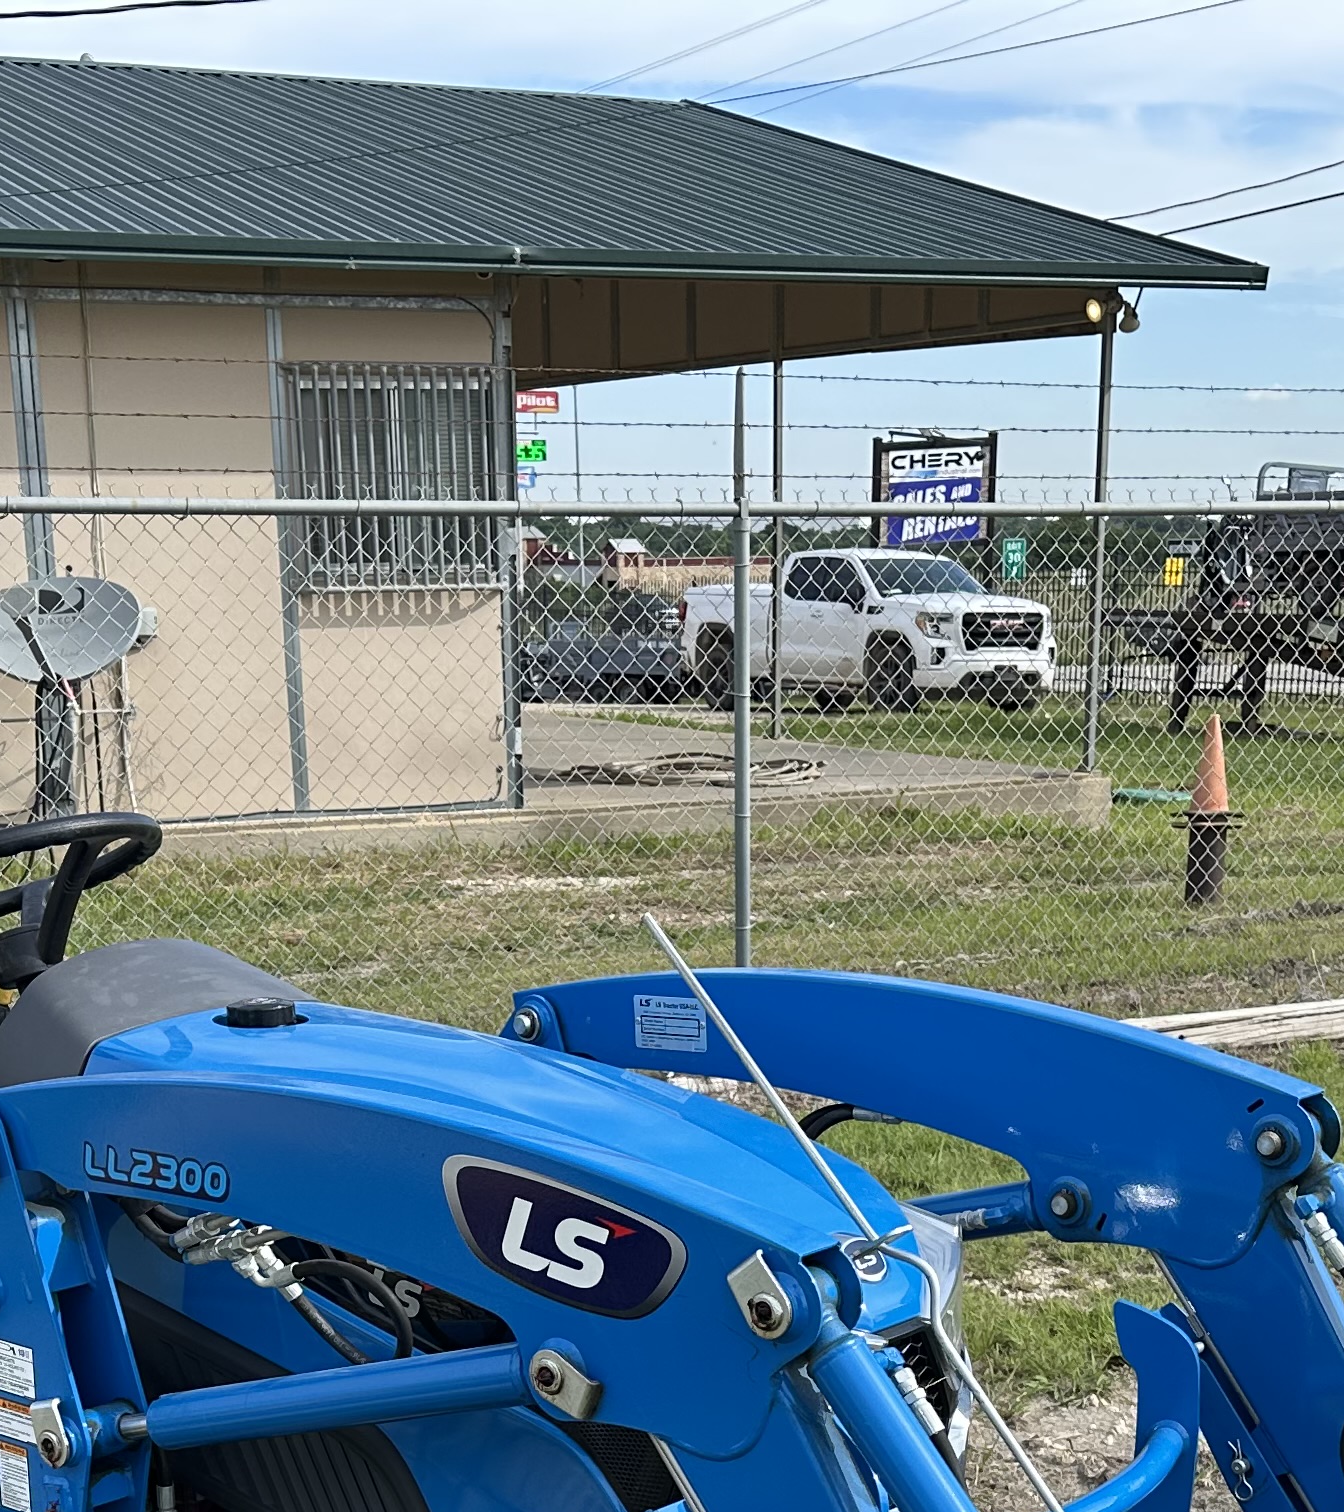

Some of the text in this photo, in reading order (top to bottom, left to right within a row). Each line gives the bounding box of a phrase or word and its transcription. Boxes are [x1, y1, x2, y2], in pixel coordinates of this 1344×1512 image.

[516, 394, 556, 408] Pilot
[891, 451, 978, 469] CHERY
[950, 483, 973, 500] AND
[1007, 552, 1021, 563] 30
[639, 998, 652, 1007] LS
[84, 1142, 228, 1199] LL2300
[502, 1197, 610, 1289] LS
